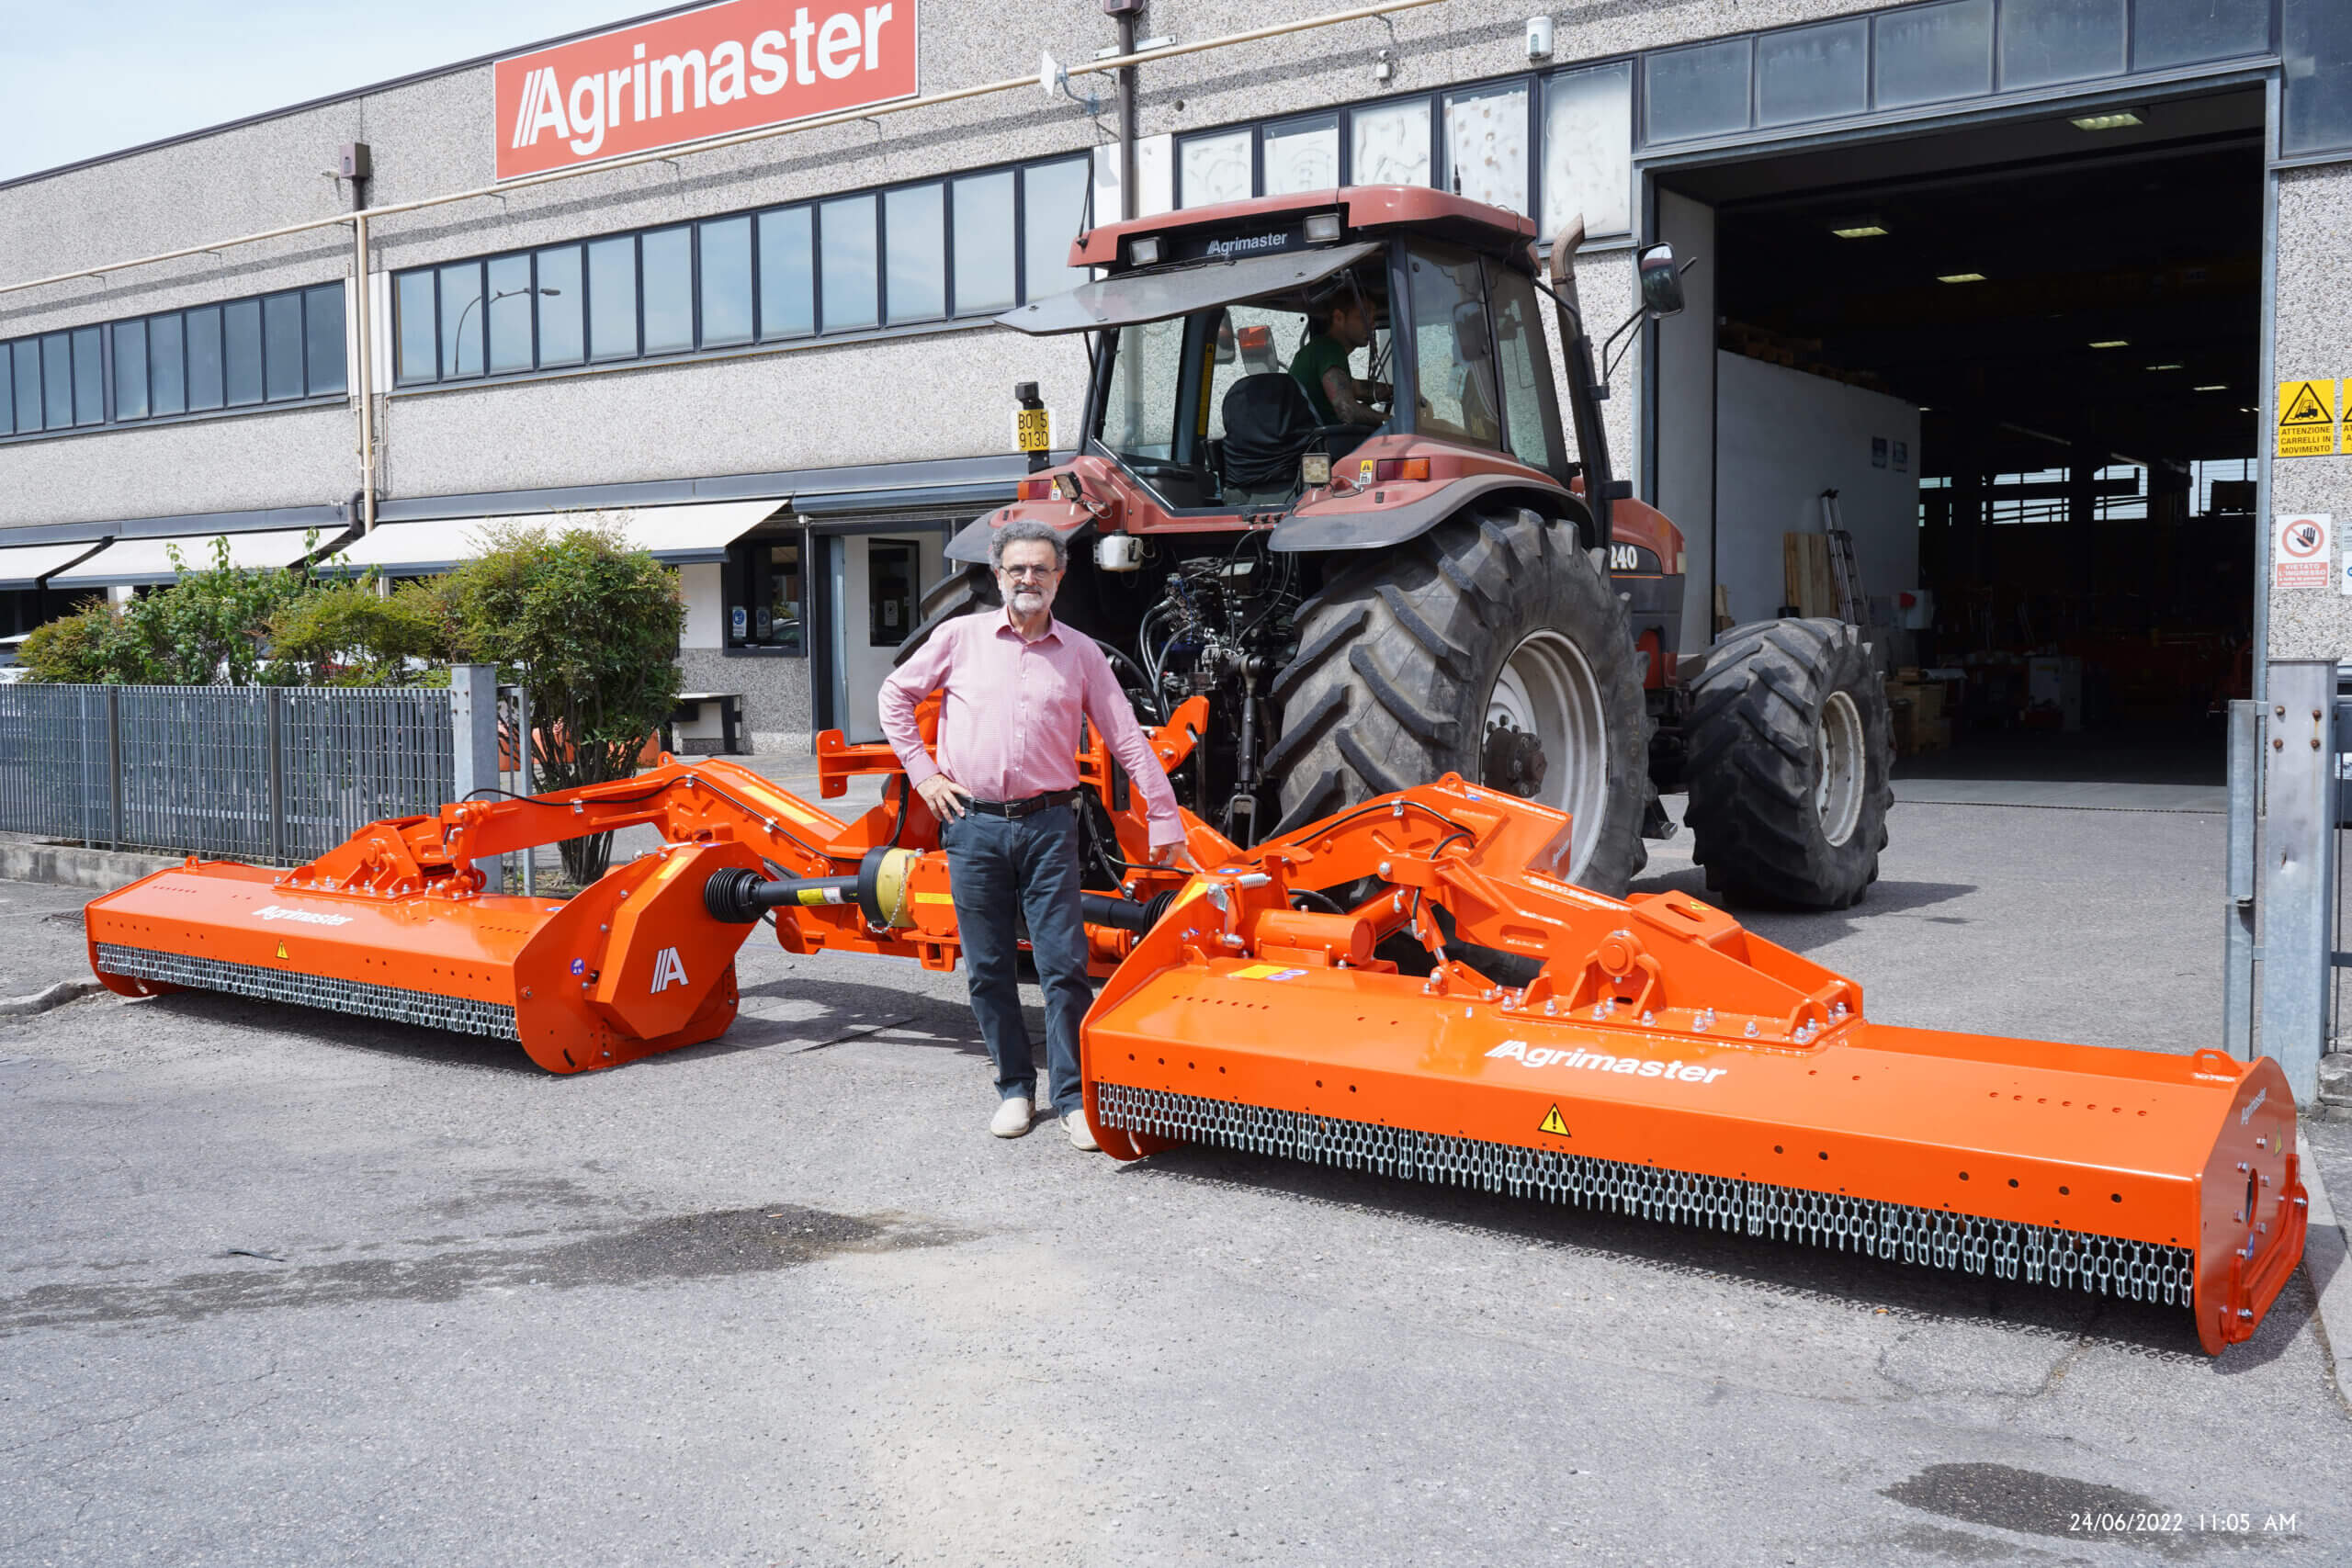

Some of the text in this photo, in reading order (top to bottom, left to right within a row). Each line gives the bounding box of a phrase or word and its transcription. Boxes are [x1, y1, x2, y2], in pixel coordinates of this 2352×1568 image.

[512, 2, 893, 156] Agrimaster
[1206, 232, 1288, 255] Agrimaster
[1040, 412, 1047, 428] 5
[2281, 426, 2331, 434] ATTENZIONE
[1019, 431, 1048, 448] 9130
[2280, 436, 2320, 445] CARRELLI
[2281, 445, 2331, 453] MOVIMENTO
[1484, 1040, 1727, 1084] Agrimaster
